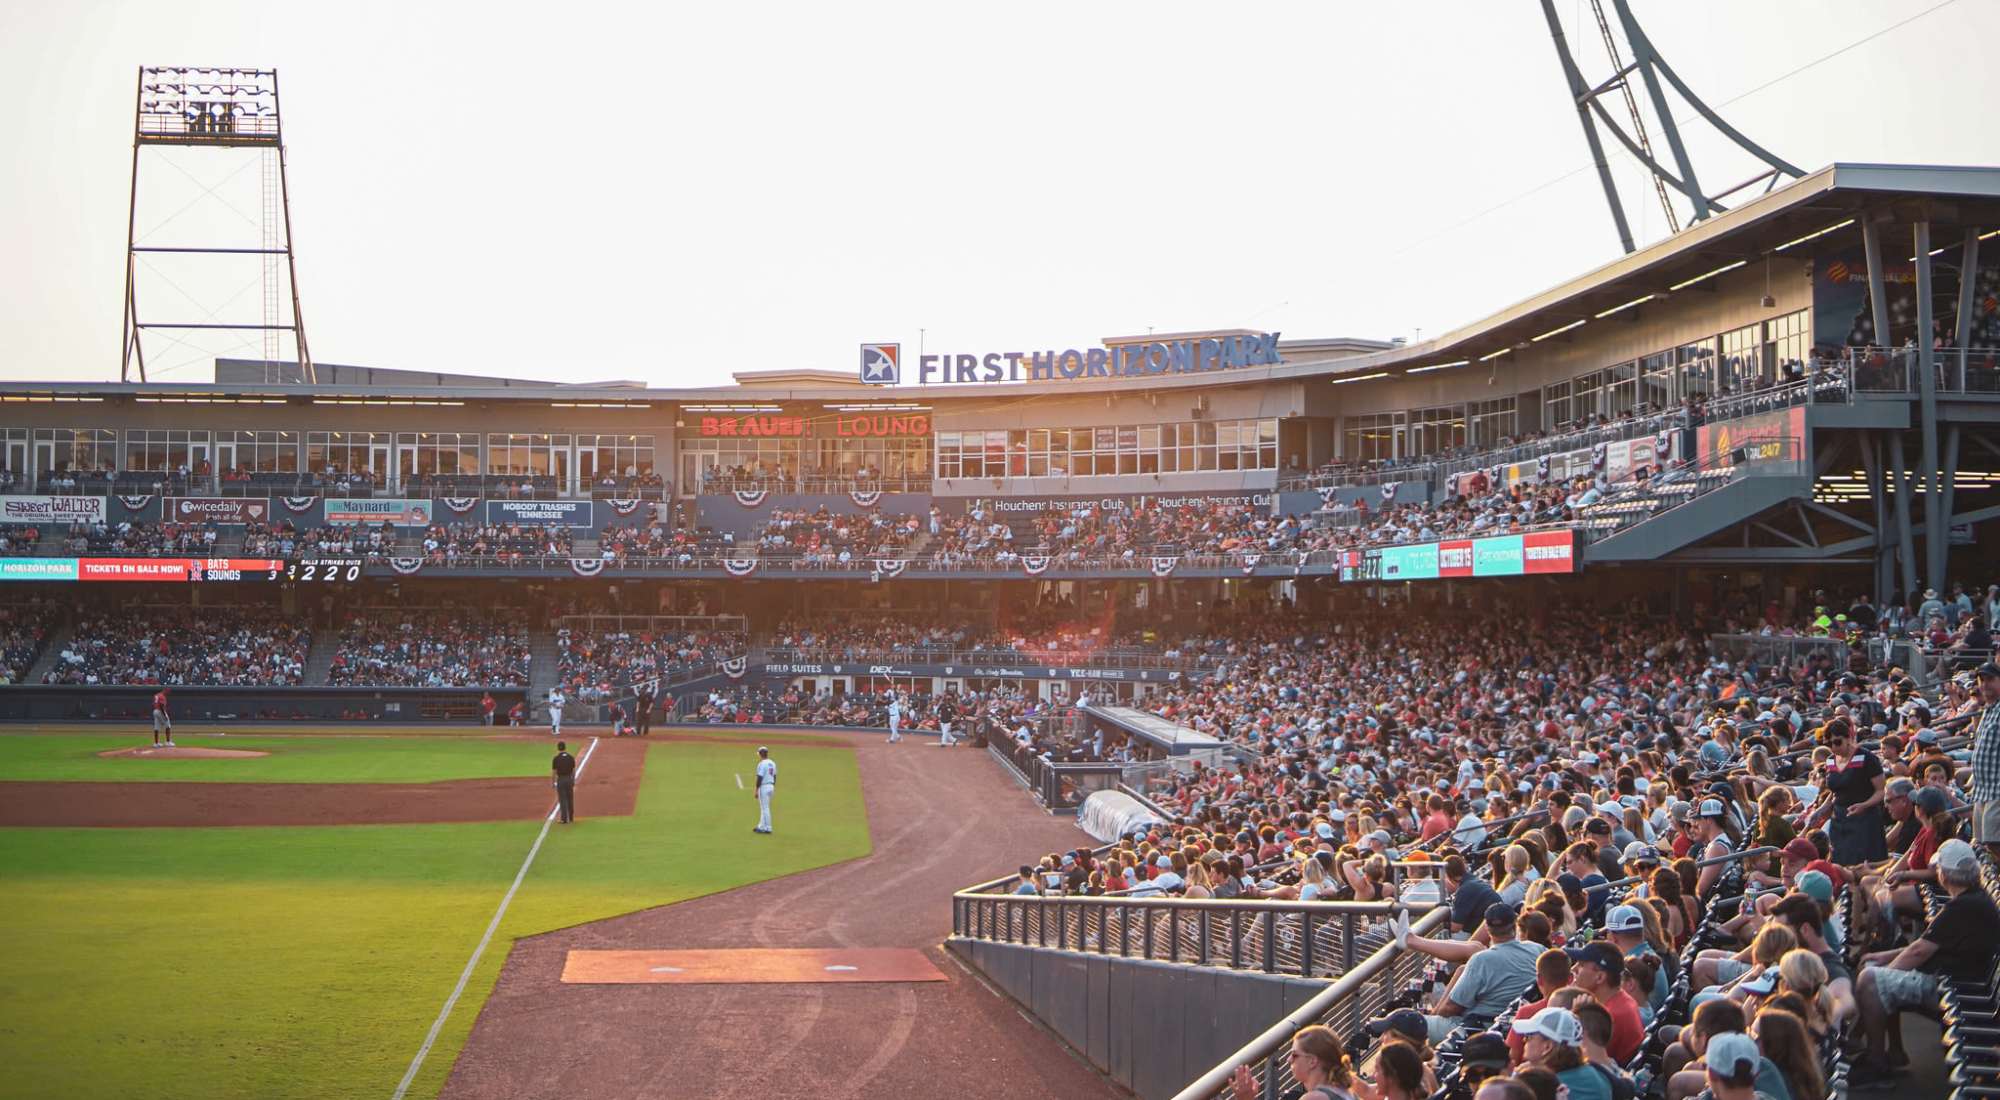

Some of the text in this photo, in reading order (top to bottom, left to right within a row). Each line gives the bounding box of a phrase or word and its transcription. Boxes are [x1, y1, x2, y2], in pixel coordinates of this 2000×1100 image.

[920, 332, 1281, 383] FIRST HORIZON PARK
[6, 497, 100, 514] SWEET WALTER
[344, 501, 390, 513] Maynard
[502, 503, 576, 511] NOBODY TRASHES
[1101, 499, 1124, 510] Club
[516, 511, 563, 519] TENNESSEE
[4, 564, 46, 573] HORIZON
[47, 564, 73, 573] PARK
[85, 564, 184, 573] TICKETS ON SALE NOW!
[207, 558, 229, 569] BATS
[207, 570, 241, 580] SOUNDS
[268, 571, 277, 580] 3
[287, 565, 296, 575] 3
[301, 566, 360, 581] 2 2 0
[766, 664, 821, 673] FIELD SUITES
[870, 665, 893, 674] DEX
